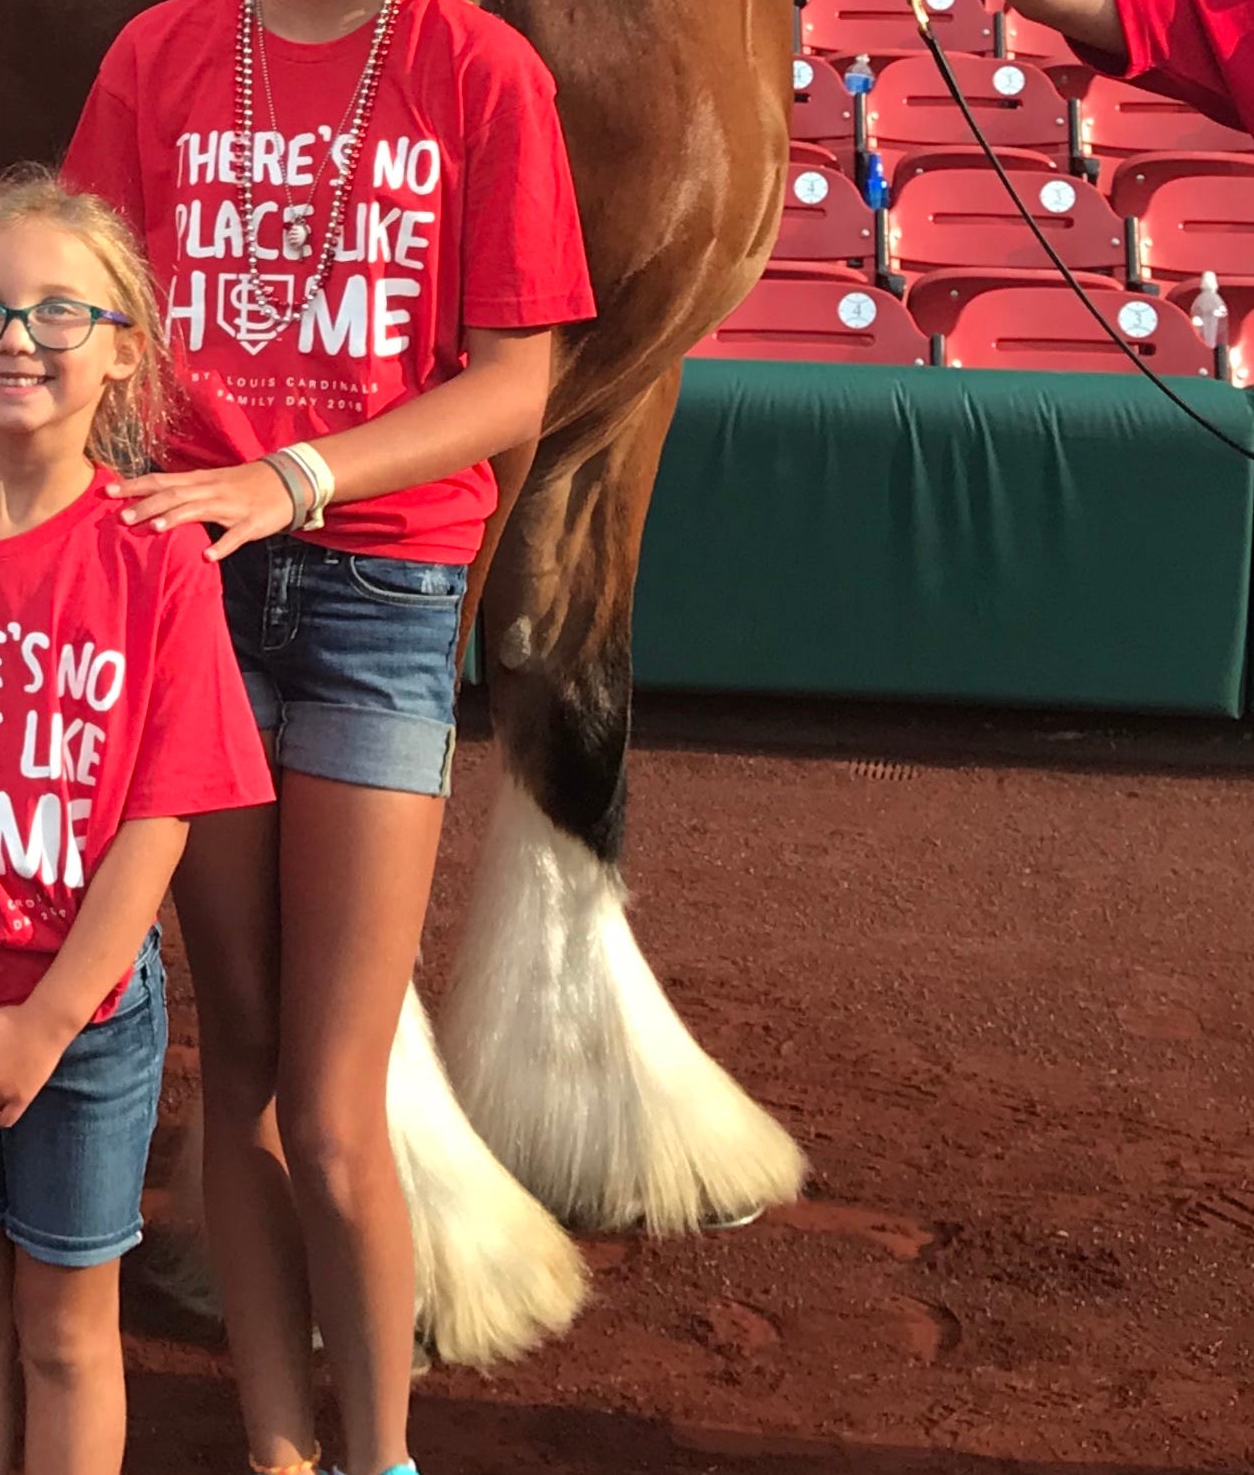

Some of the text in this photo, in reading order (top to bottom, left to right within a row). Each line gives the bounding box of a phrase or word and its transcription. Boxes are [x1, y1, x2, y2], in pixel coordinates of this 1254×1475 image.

[373, 136, 441, 195] NO
[217, 388, 275, 407] FAMILY
[285, 395, 318, 406] DAY
[226, 376, 276, 388] LOUIS
[285, 376, 378, 395] CARDINALS
[58, 642, 126, 712] NO
[20, 709, 106, 787] LIKE
